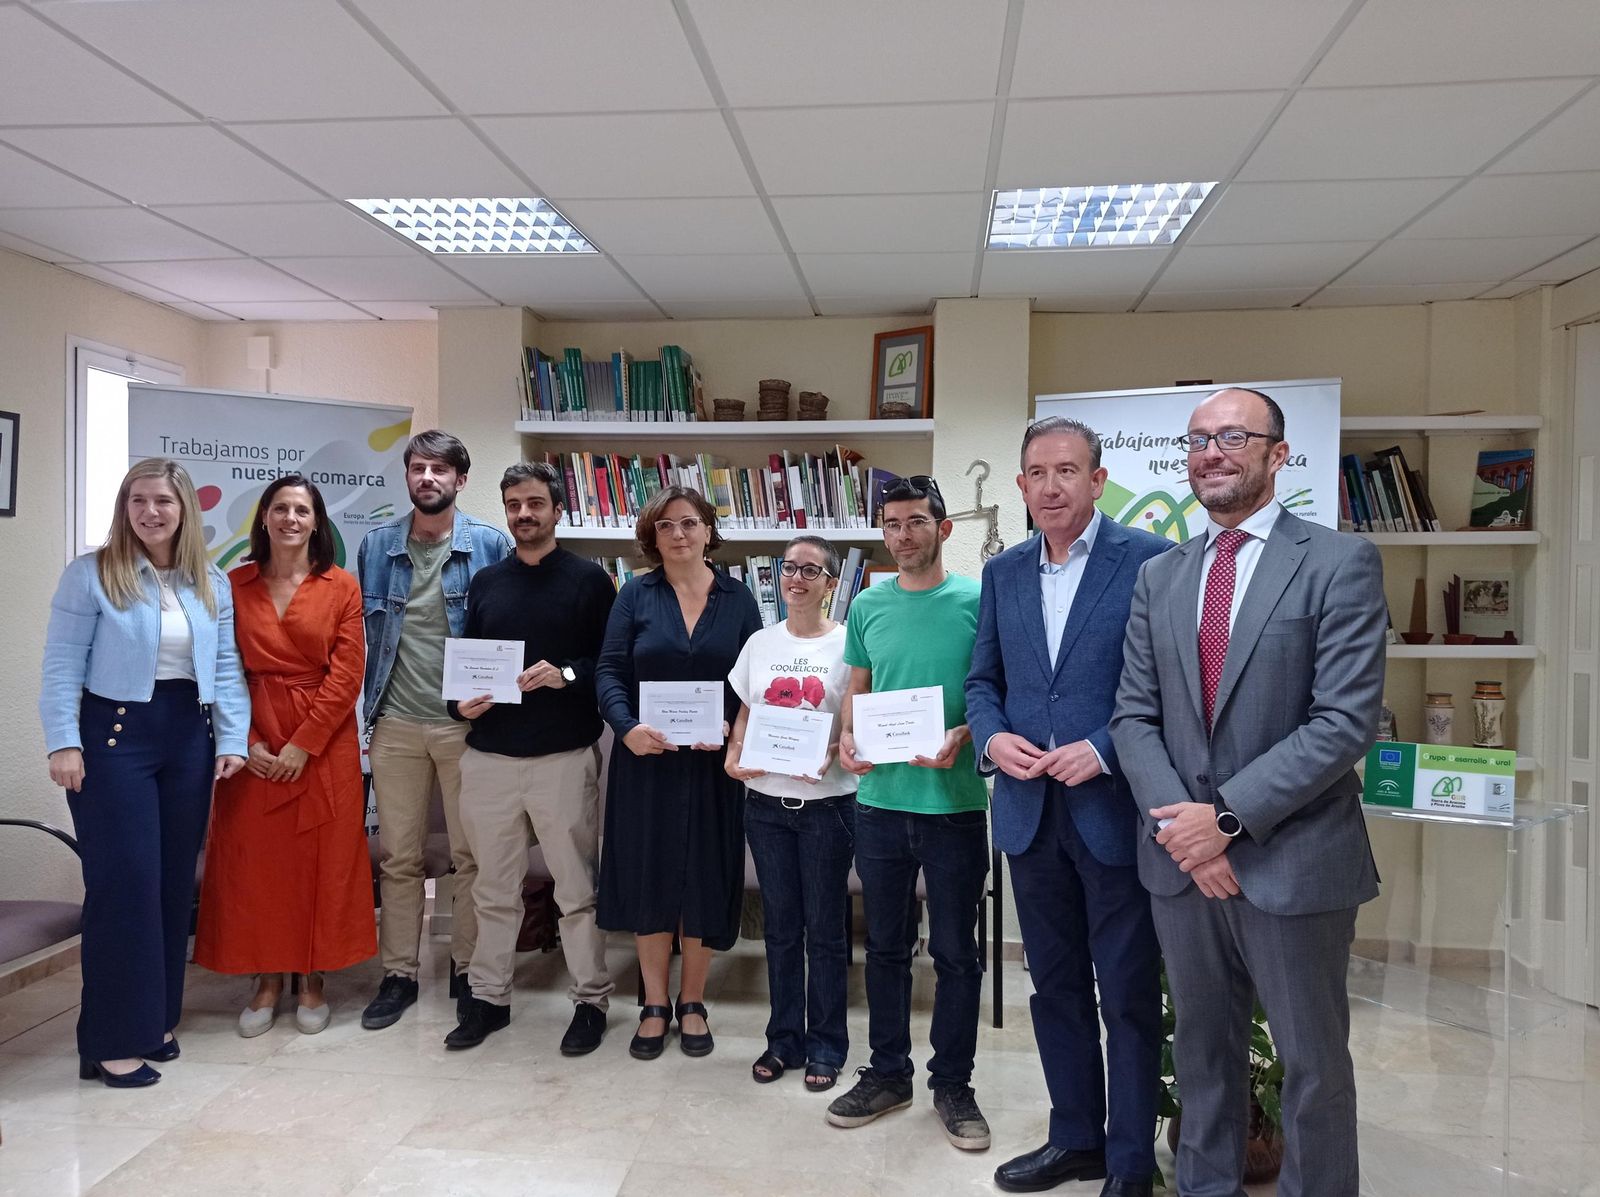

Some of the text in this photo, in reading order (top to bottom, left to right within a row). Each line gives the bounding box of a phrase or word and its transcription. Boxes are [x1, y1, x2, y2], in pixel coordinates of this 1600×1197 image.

[159, 435, 305, 464] Trabajamos por
[311, 471, 385, 487] comarca
[343, 512, 365, 520] Europa
[770, 664, 829, 674] COQUELICOTS
[1423, 752, 1511, 766] Grupo Desarrollo Rural
